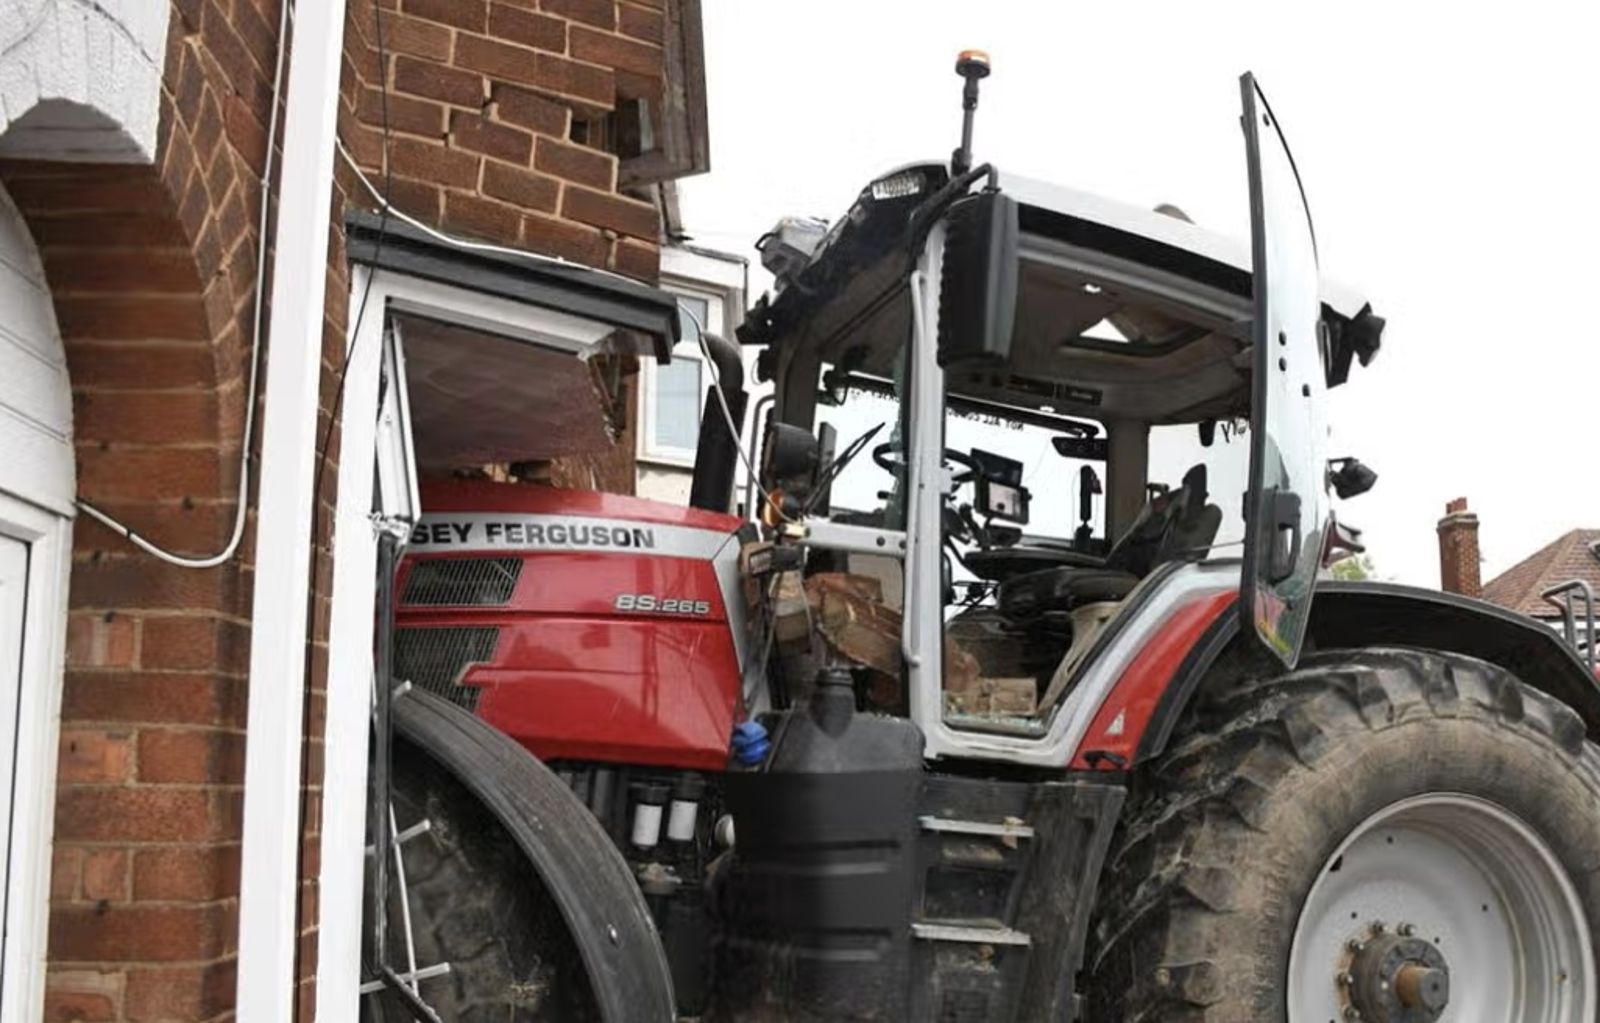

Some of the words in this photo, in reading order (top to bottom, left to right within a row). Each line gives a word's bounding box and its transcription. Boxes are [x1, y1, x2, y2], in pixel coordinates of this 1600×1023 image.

[410, 522, 473, 544] SEY
[485, 522, 655, 549] FERGUSON
[615, 593, 711, 615] 8S.265
